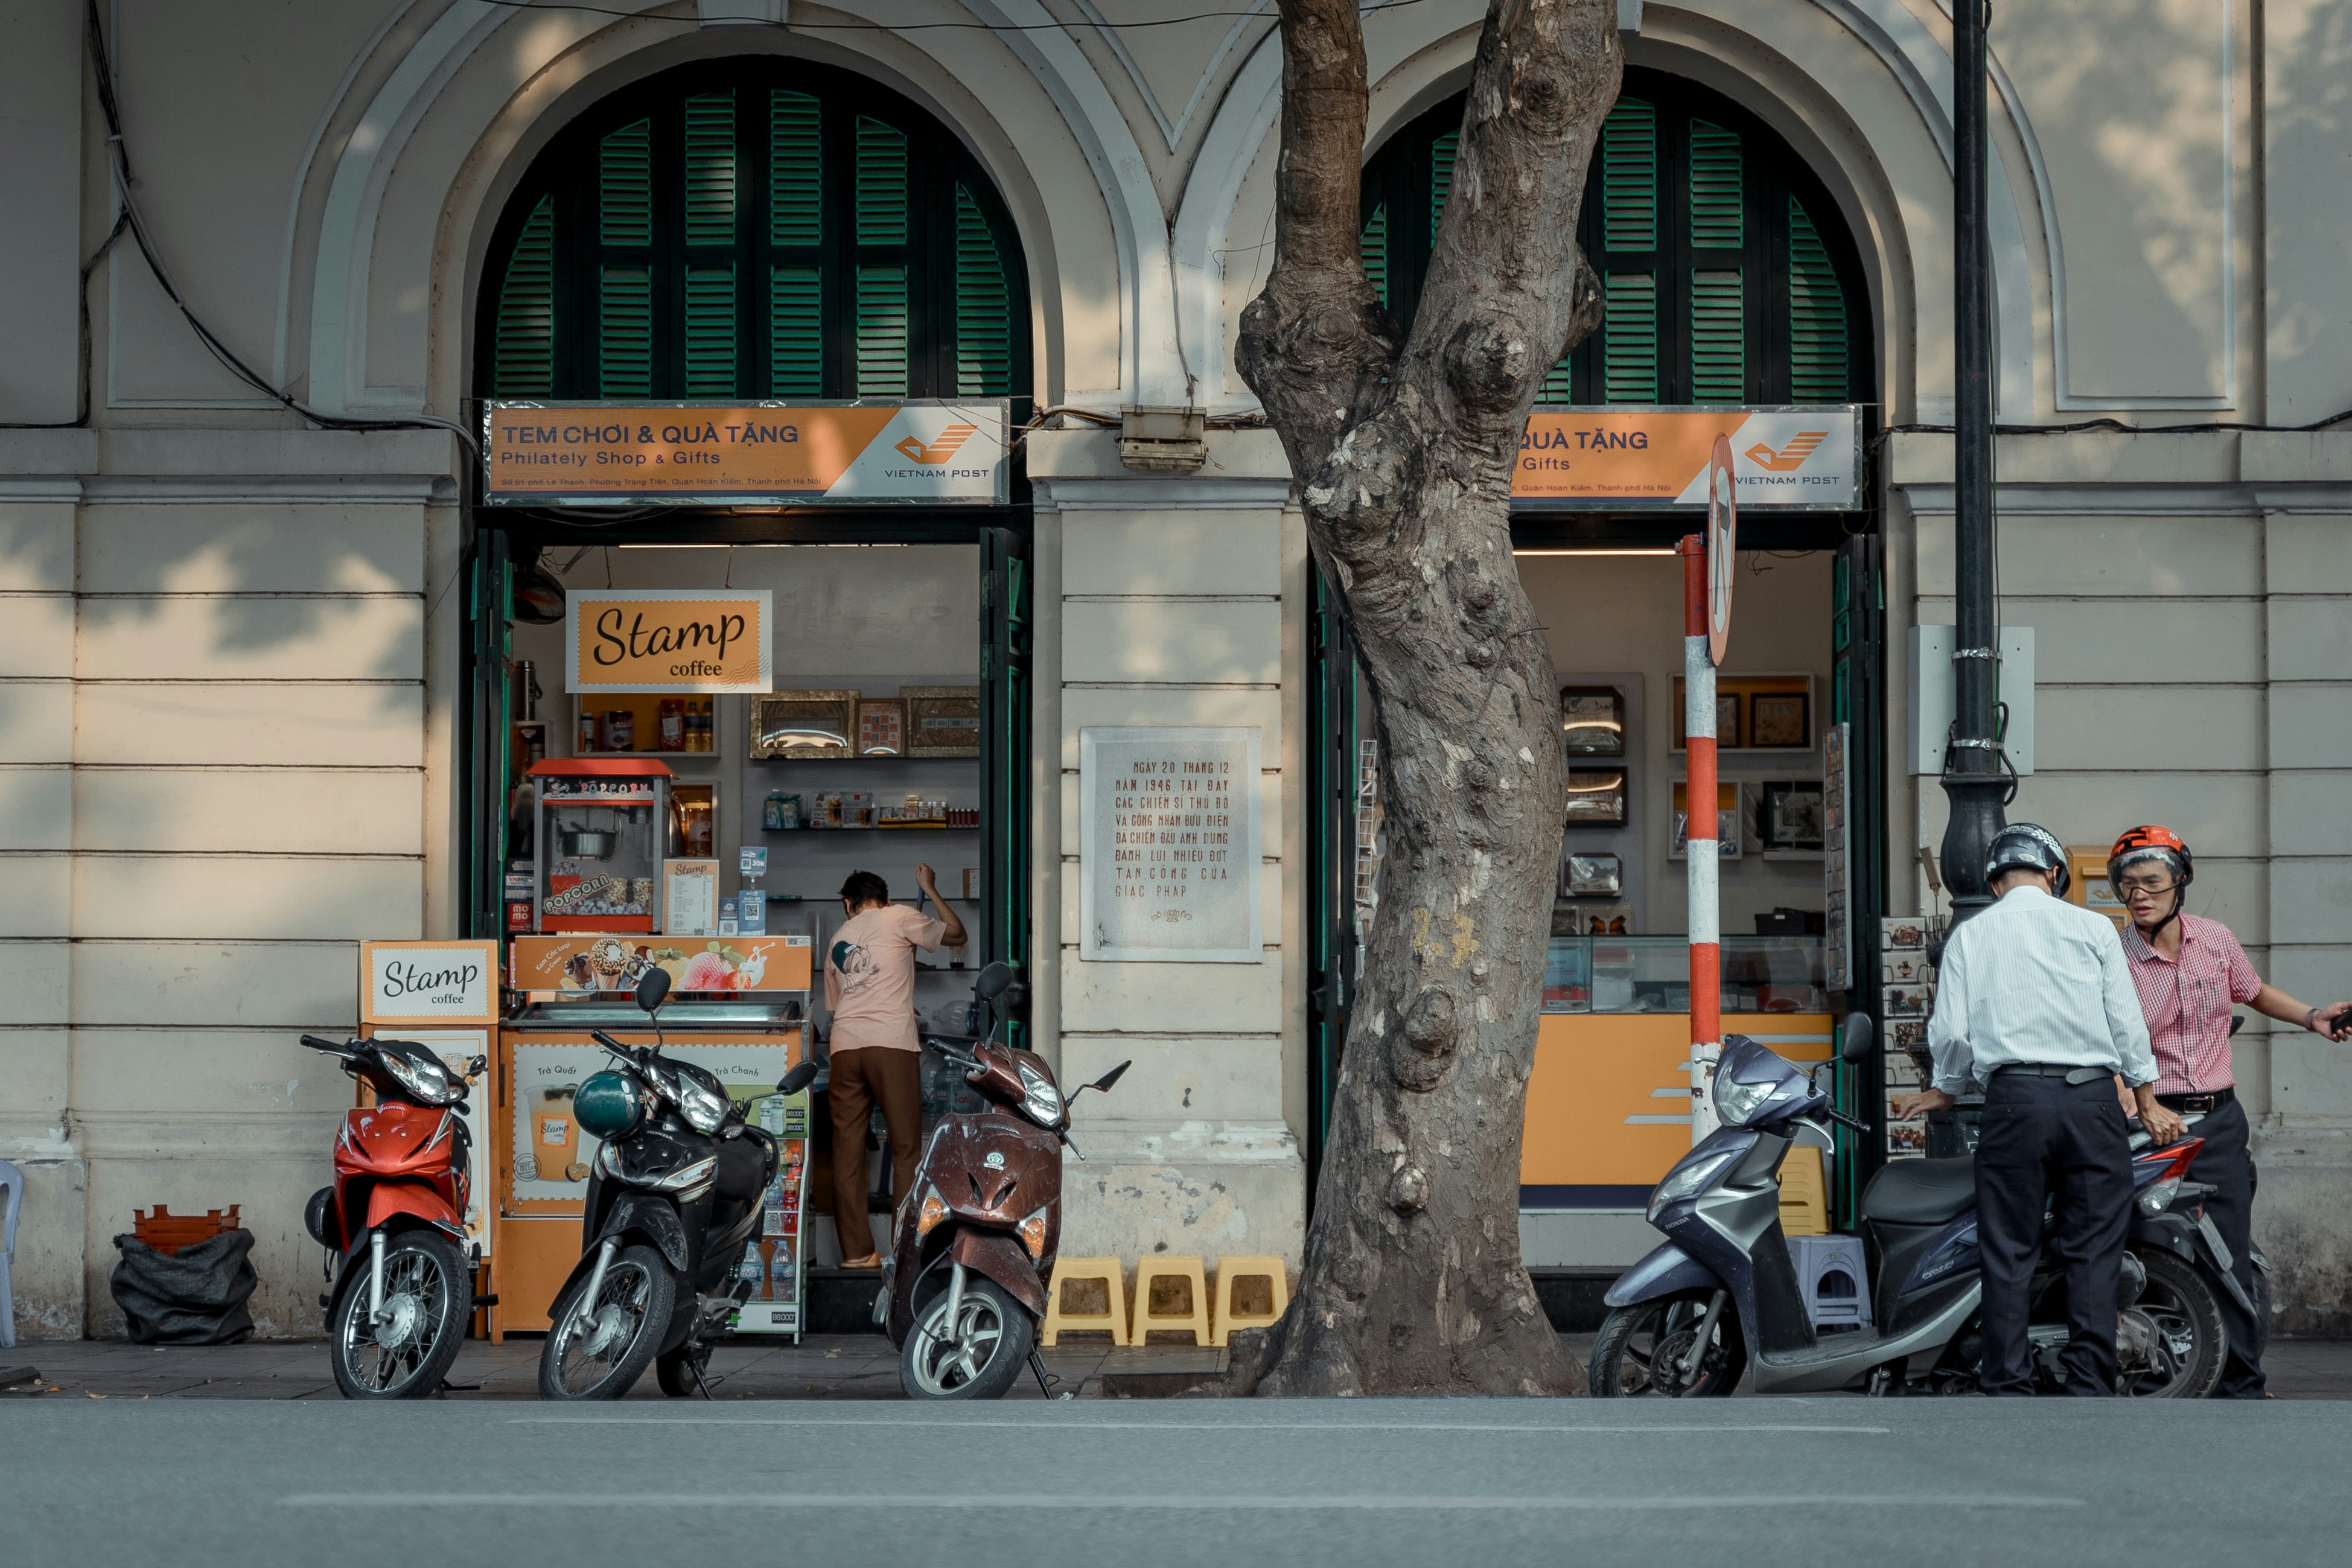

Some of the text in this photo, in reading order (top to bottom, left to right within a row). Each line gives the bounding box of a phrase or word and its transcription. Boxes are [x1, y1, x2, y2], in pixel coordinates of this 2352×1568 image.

[502, 421, 798, 447] TEM CHƠI & QUÀ TẶNG
[1520, 427, 1648, 453] QUÀ TẶNG
[501, 451, 721, 467] Philately Shop & Gifts
[1523, 457, 1570, 470] Gifts
[884, 470, 946, 478] VIETNAM
[593, 608, 745, 666] Stamp
[669, 660, 722, 677] coffee
[1133, 758, 1229, 774] NGÀY 20 THÁNG 12
[581, 783, 648, 794] POPCORN
[675, 864, 707, 876] Stamp
[544, 873, 610, 913] POPCORN
[535, 958, 547, 971] Kem
[383, 961, 478, 998] Stamp
[431, 993, 464, 1004] coffee
[537, 1065, 576, 1076] Trà Quất
[714, 1065, 759, 1077] Trà Chanh
[540, 1122, 570, 1135] Stamp
[646, 1130, 674, 1141] HONDA
[1665, 1216, 1690, 1231] HONDA
